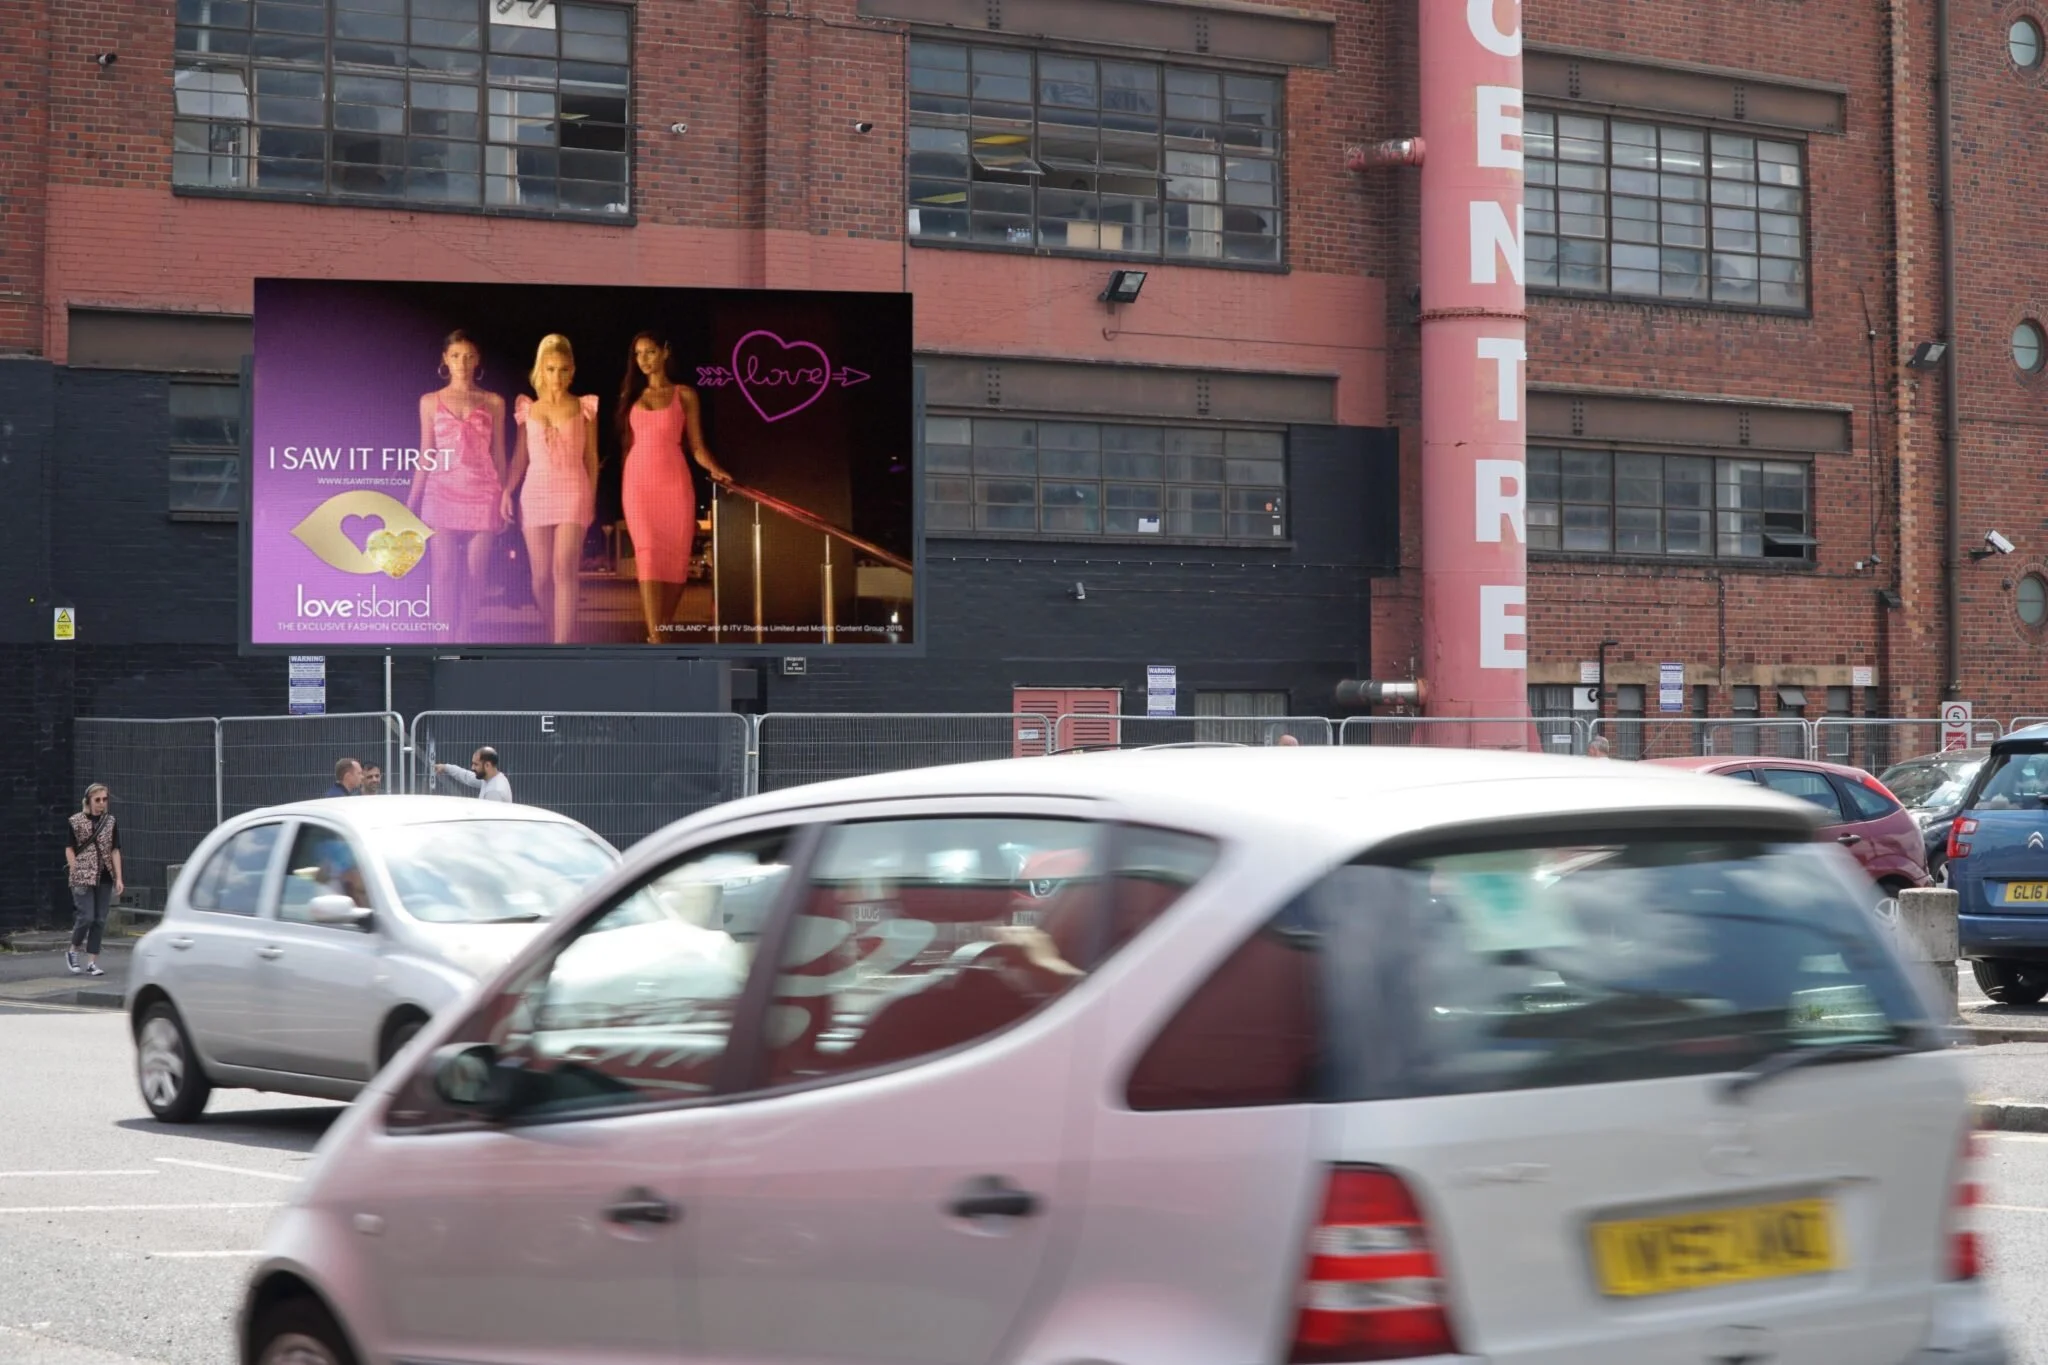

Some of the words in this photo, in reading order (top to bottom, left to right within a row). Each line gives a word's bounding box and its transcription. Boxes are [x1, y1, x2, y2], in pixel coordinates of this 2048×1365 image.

[1465, 0, 1526, 669] CENTRE
[744, 355, 824, 386] love
[269, 446, 275, 470] I
[282, 446, 342, 471] SAW
[349, 447, 374, 471] IT
[382, 447, 455, 472] FIRST
[317, 476, 411, 486] WWW.ISAWITFIRST.COM
[277, 621, 295, 631] THE
[297, 621, 346, 631] EXCLUSIVE
[349, 622, 389, 631] FASHION
[391, 622, 449, 632] COLLECTION
[655, 624, 673, 632] LOVE
[729, 624, 742, 632] ITV
[743, 624, 769, 632] Studios
[770, 624, 795, 632] Limited
[796, 624, 809, 632] and
[835, 624, 863, 632] Content
[863, 624, 885, 633] Group
[541, 715, 555, 733] E
